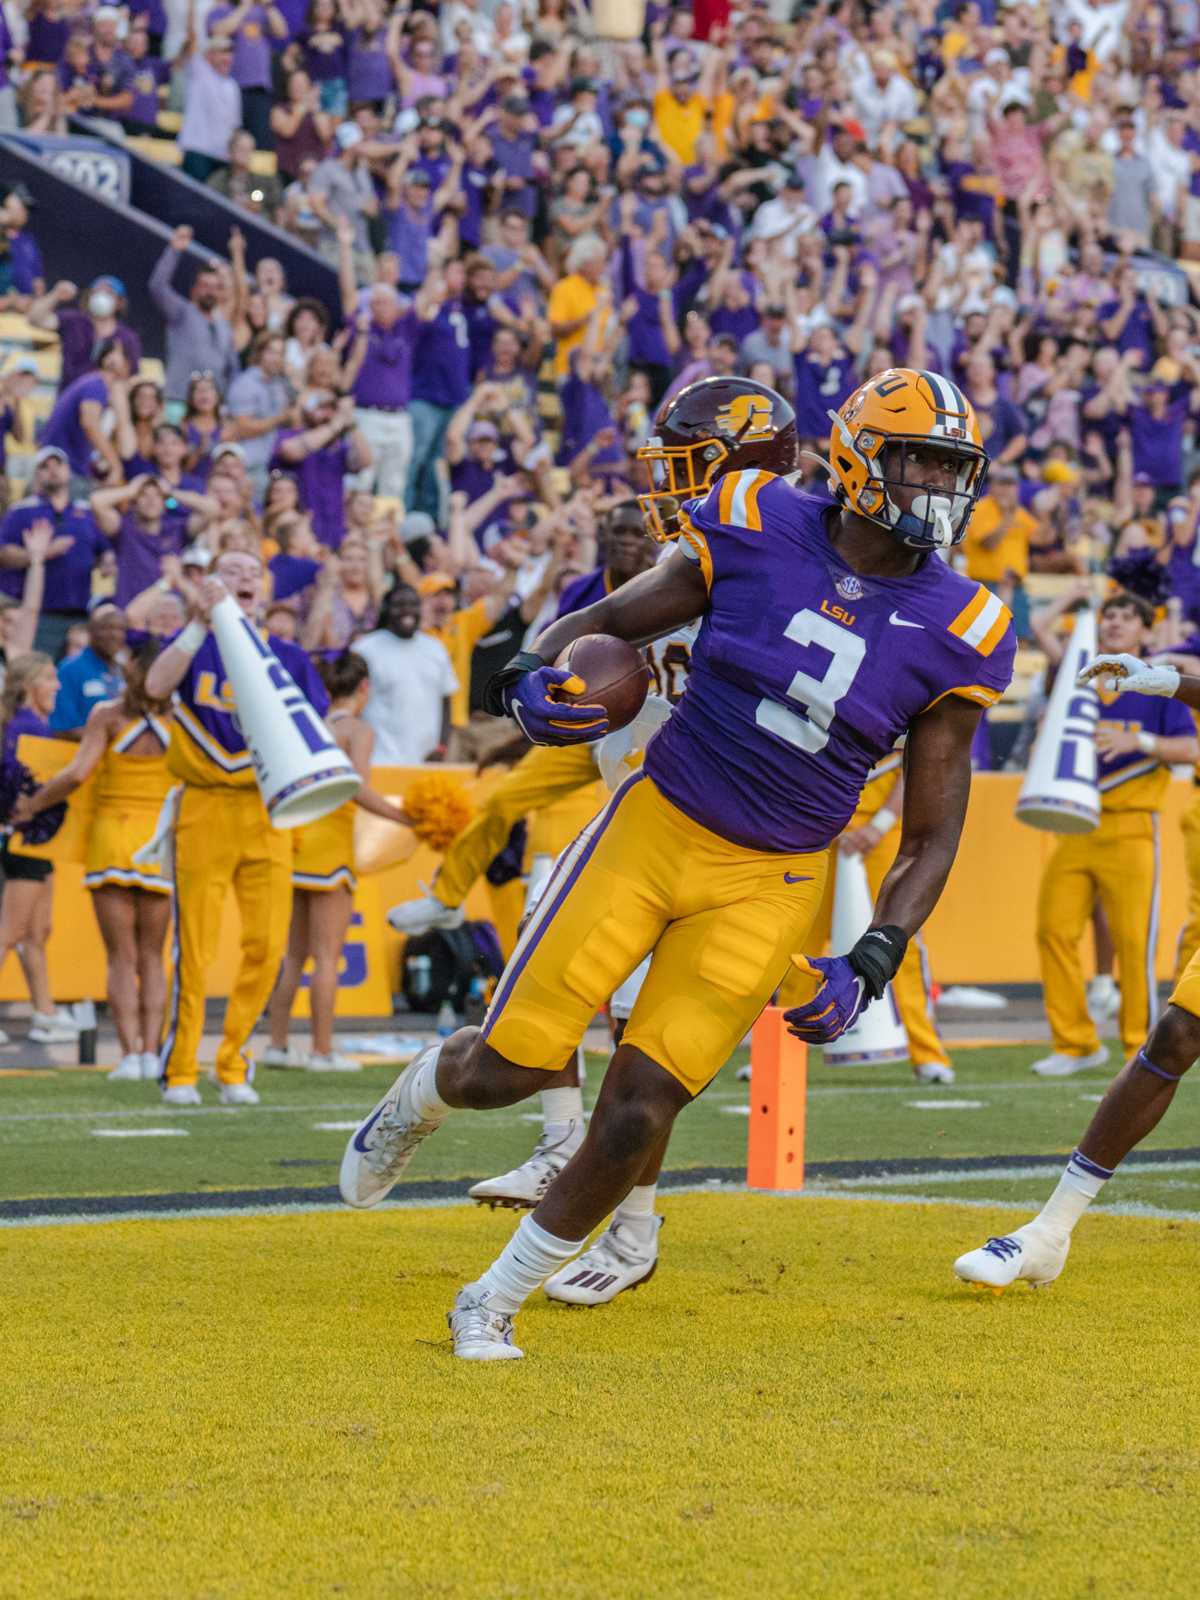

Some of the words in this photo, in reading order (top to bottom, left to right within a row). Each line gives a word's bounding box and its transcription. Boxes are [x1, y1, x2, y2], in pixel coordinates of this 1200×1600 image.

[944, 426, 967, 440] LSU
[820, 599, 857, 626] LSU
[755, 607, 867, 755] 3
